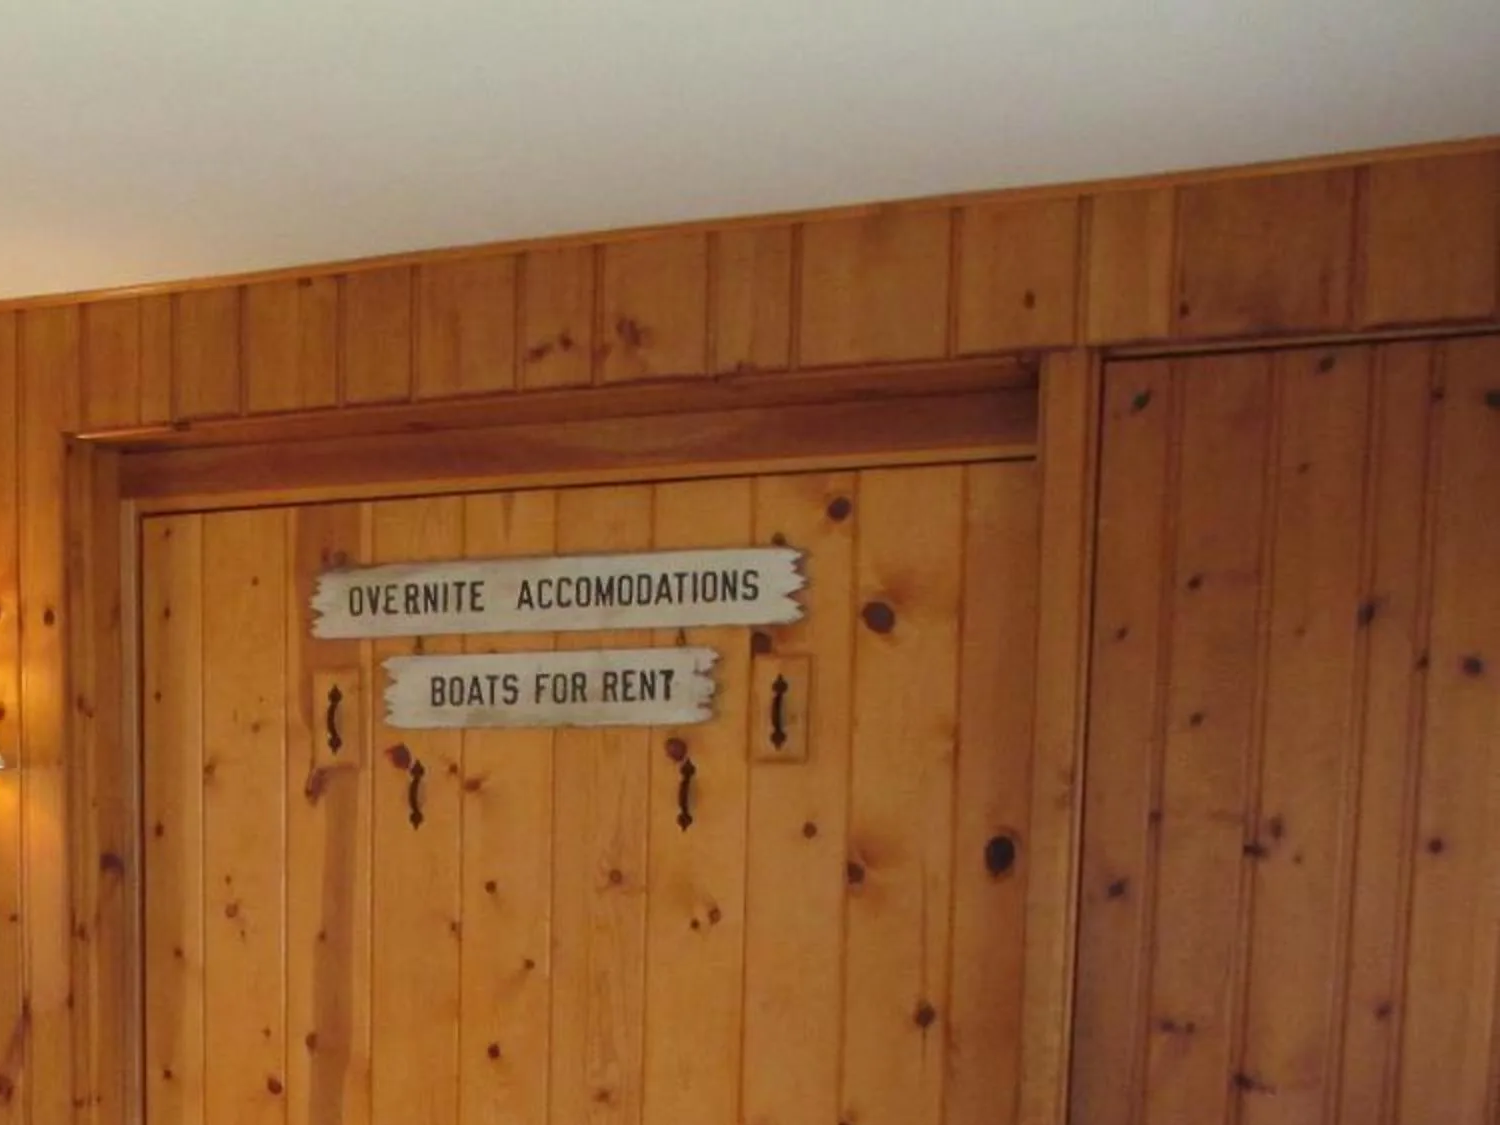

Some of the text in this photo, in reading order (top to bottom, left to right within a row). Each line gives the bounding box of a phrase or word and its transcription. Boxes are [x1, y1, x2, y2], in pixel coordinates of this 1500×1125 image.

[348, 570, 760, 617] OVERNITE ACCOMODATIONS
[430, 669, 675, 707] BOATS FOR RENT
